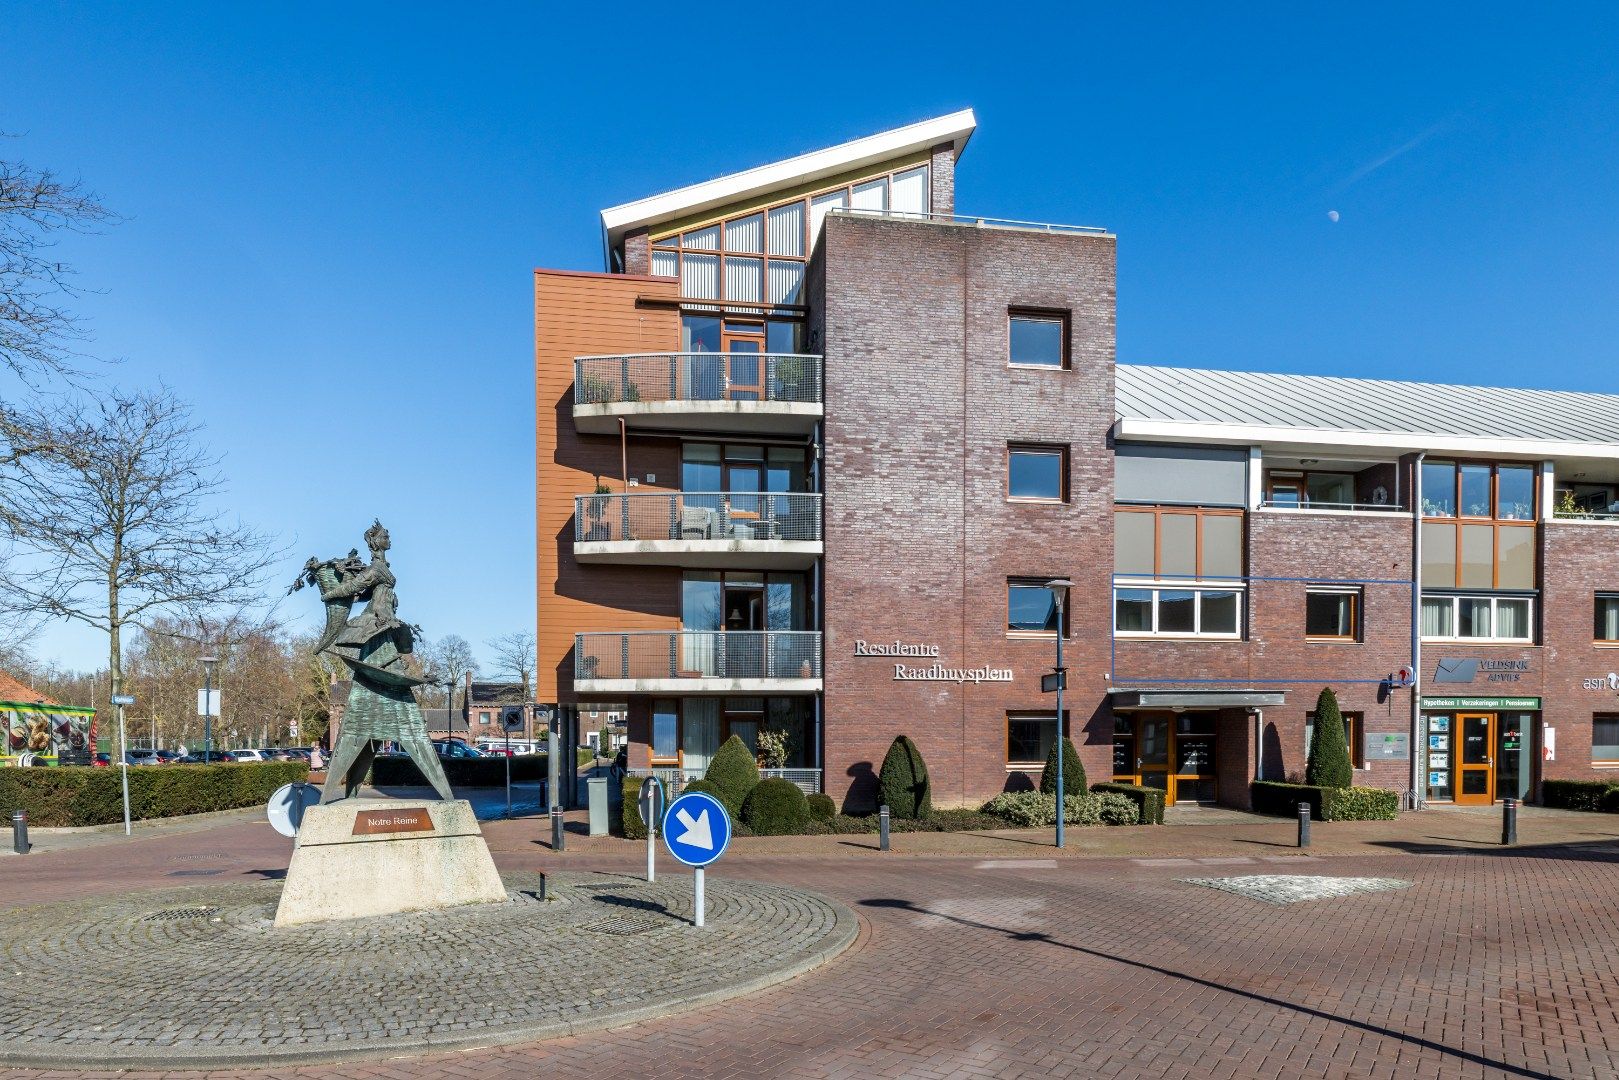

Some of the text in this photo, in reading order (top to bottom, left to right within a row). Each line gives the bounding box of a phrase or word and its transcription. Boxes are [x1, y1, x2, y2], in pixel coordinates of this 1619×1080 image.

[854, 640, 939, 656] Residentie
[1480, 660, 1528, 669] VELDSINK
[894, 664, 1013, 683] Raadhuysplein
[1487, 673, 1520, 681] ADVIES
[1582, 678, 1606, 690] asn
[1423, 699, 1455, 707] Hypotheken
[1461, 699, 1499, 707] Verzekeringen
[367, 816, 418, 827] Notre Reine
